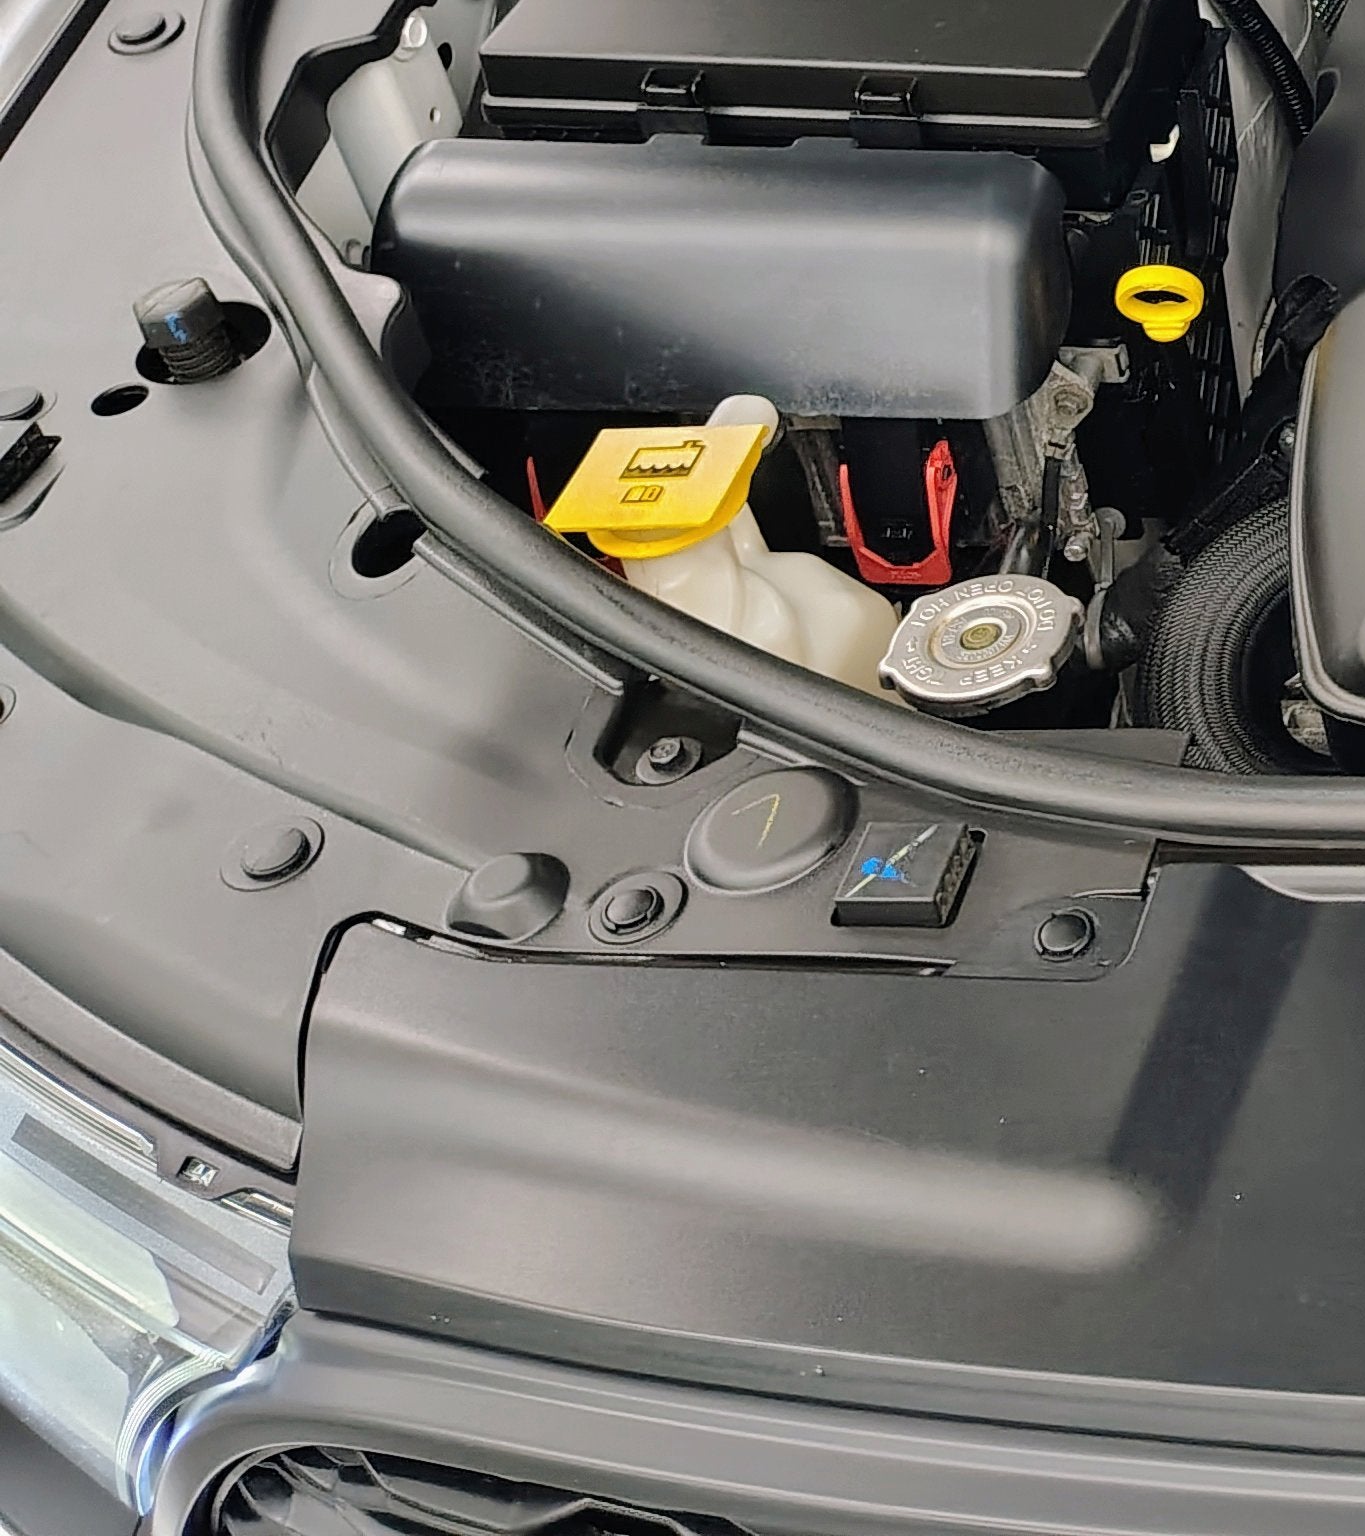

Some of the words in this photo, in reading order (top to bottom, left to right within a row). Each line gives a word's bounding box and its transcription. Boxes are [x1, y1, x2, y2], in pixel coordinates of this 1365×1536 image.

[955, 579, 1014, 601] OPEN
[910, 598, 951, 629] HOT
[960, 655, 1023, 686] KEEP
